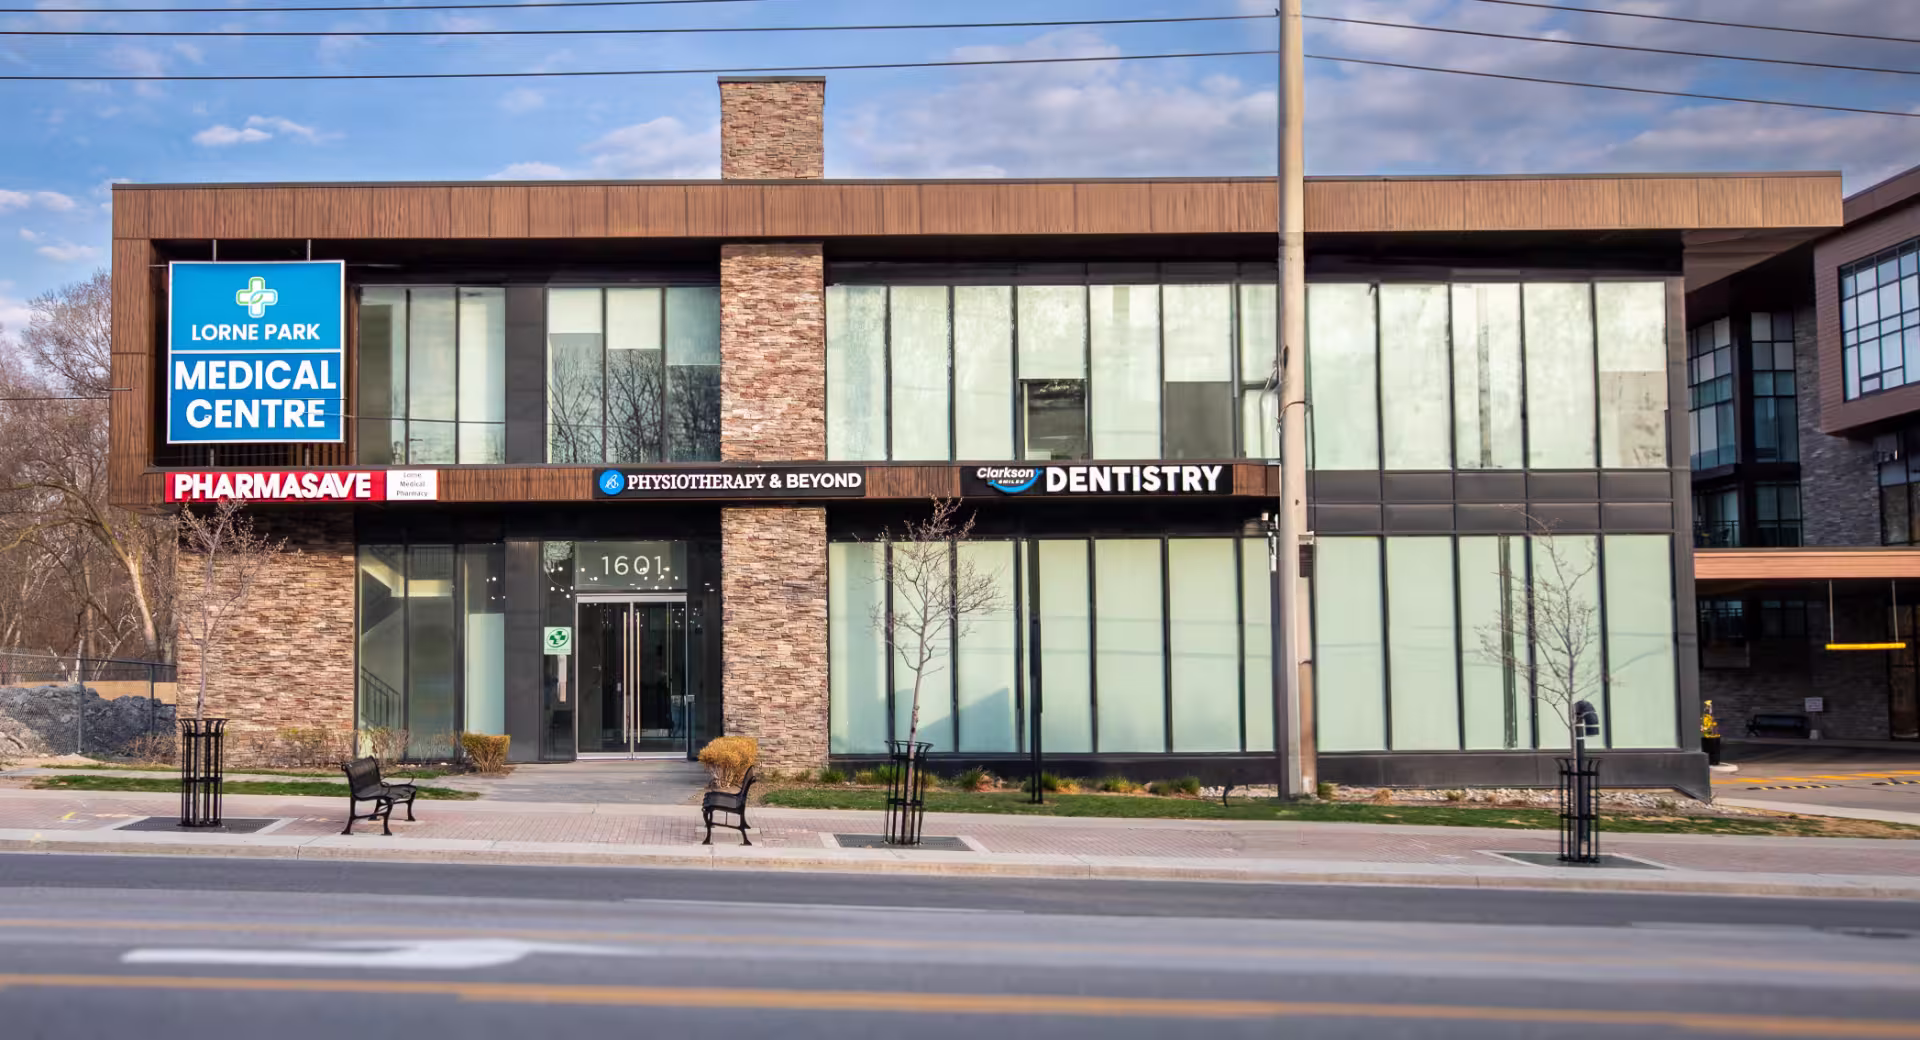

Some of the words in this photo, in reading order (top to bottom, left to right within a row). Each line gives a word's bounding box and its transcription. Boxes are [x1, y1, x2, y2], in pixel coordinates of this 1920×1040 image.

[192, 324, 259, 341] LORNE
[265, 323, 321, 340] PARK
[174, 360, 337, 390] MEDICAL
[186, 399, 326, 428] CENTRE
[627, 473, 765, 490] PHYSIOTHERAPY
[769, 474, 782, 488] &
[786, 473, 862, 488] BEYOND
[977, 467, 1034, 478] Clarkson
[1046, 466, 1222, 492] DENTISTRY
[174, 473, 372, 499] PHARMASAVE
[601, 555, 662, 575] 1601
